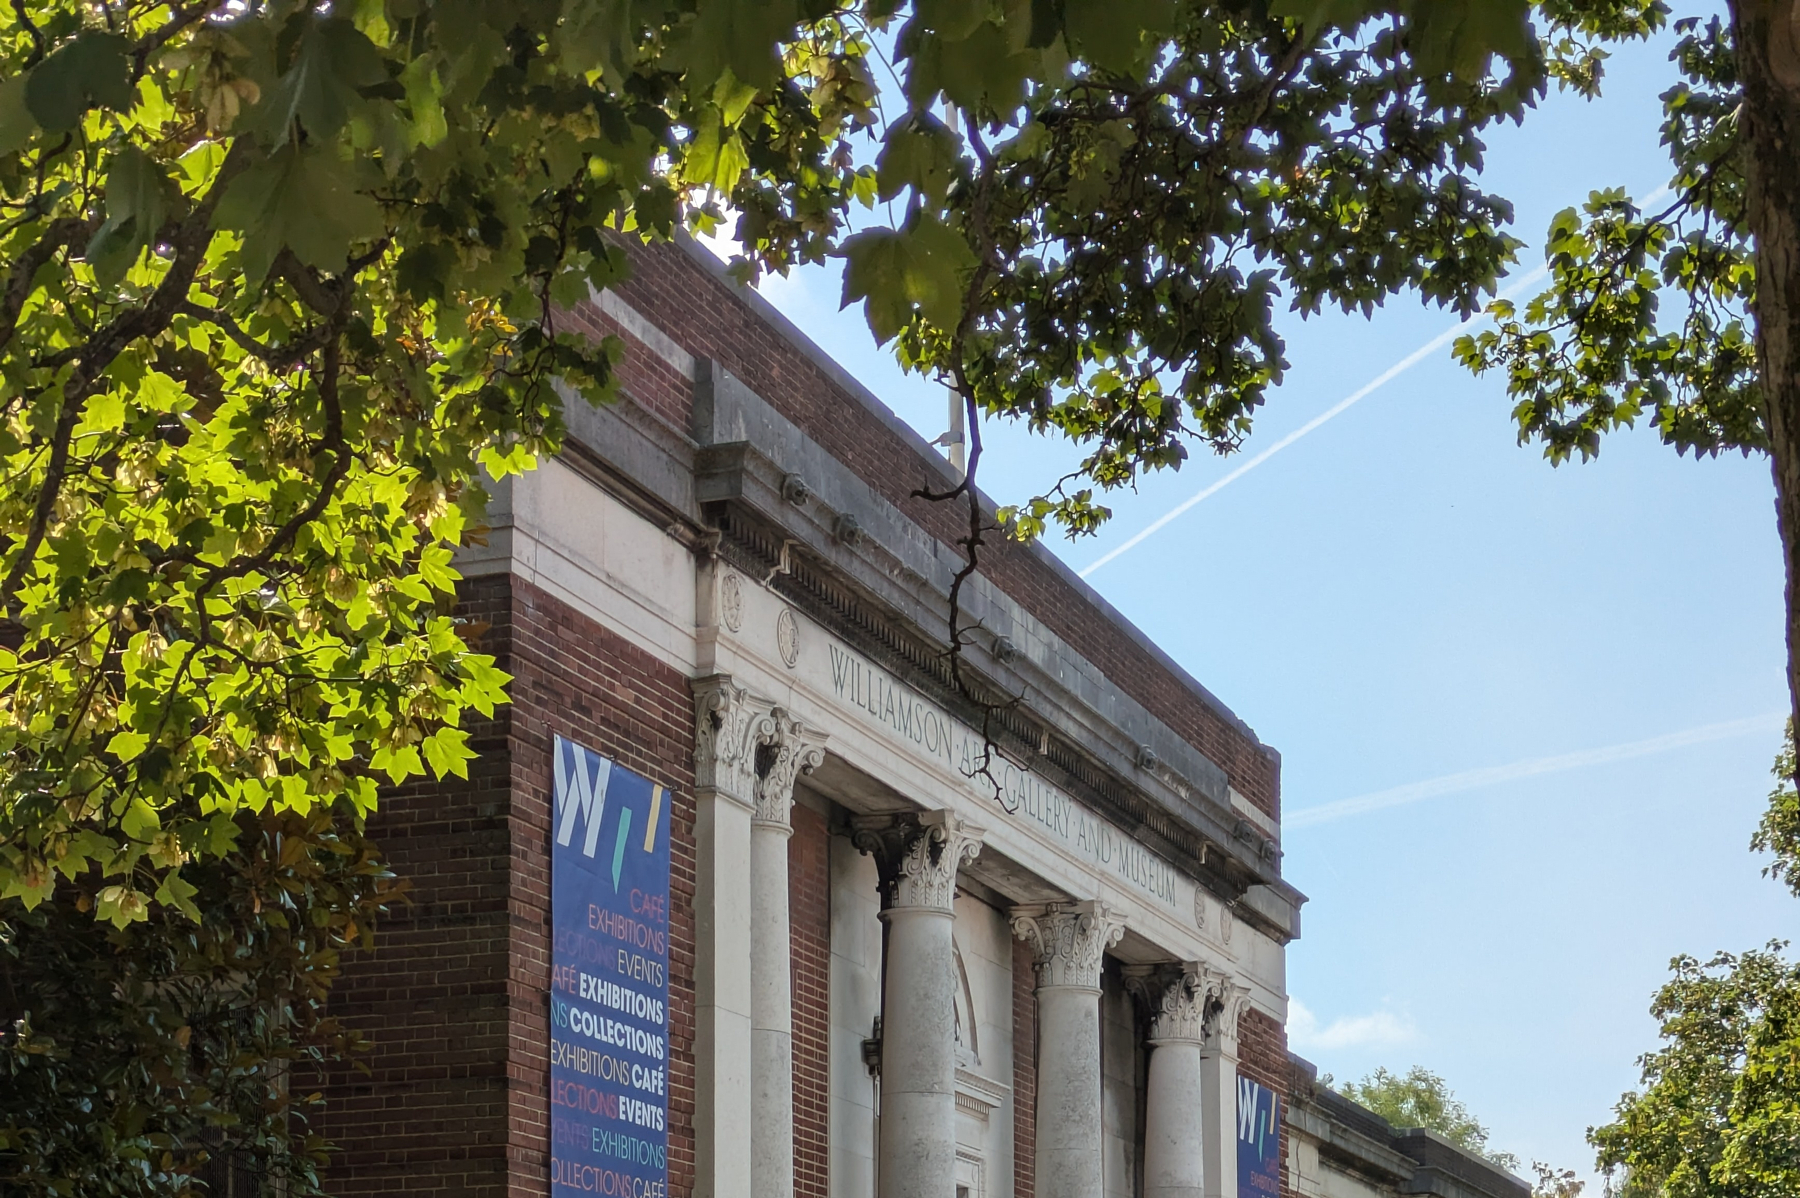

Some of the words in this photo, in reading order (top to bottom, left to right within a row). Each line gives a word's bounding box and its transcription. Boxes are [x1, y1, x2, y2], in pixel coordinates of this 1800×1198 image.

[829, 643, 953, 765] WILLIAMSON
[1004, 765, 1073, 840] GALLERY
[1078, 816, 1112, 865] AND
[1119, 844, 1177, 908] MUSEUM
[588, 903, 664, 956] EXHIBITIONS
[630, 888, 664, 924] CAFÉ
[552, 963, 576, 995] AFÉ
[580, 972, 663, 1025] EXHIBITIONS
[618, 949, 663, 988] EVENTS
[570, 1007, 663, 1060] COLLECTIONS
[551, 1038, 630, 1086] EXHIBITIONS
[632, 1065, 664, 1096] CAFÉ
[619, 1095, 663, 1132] EVENTS
[592, 1127, 665, 1170] EXHIBITIONS
